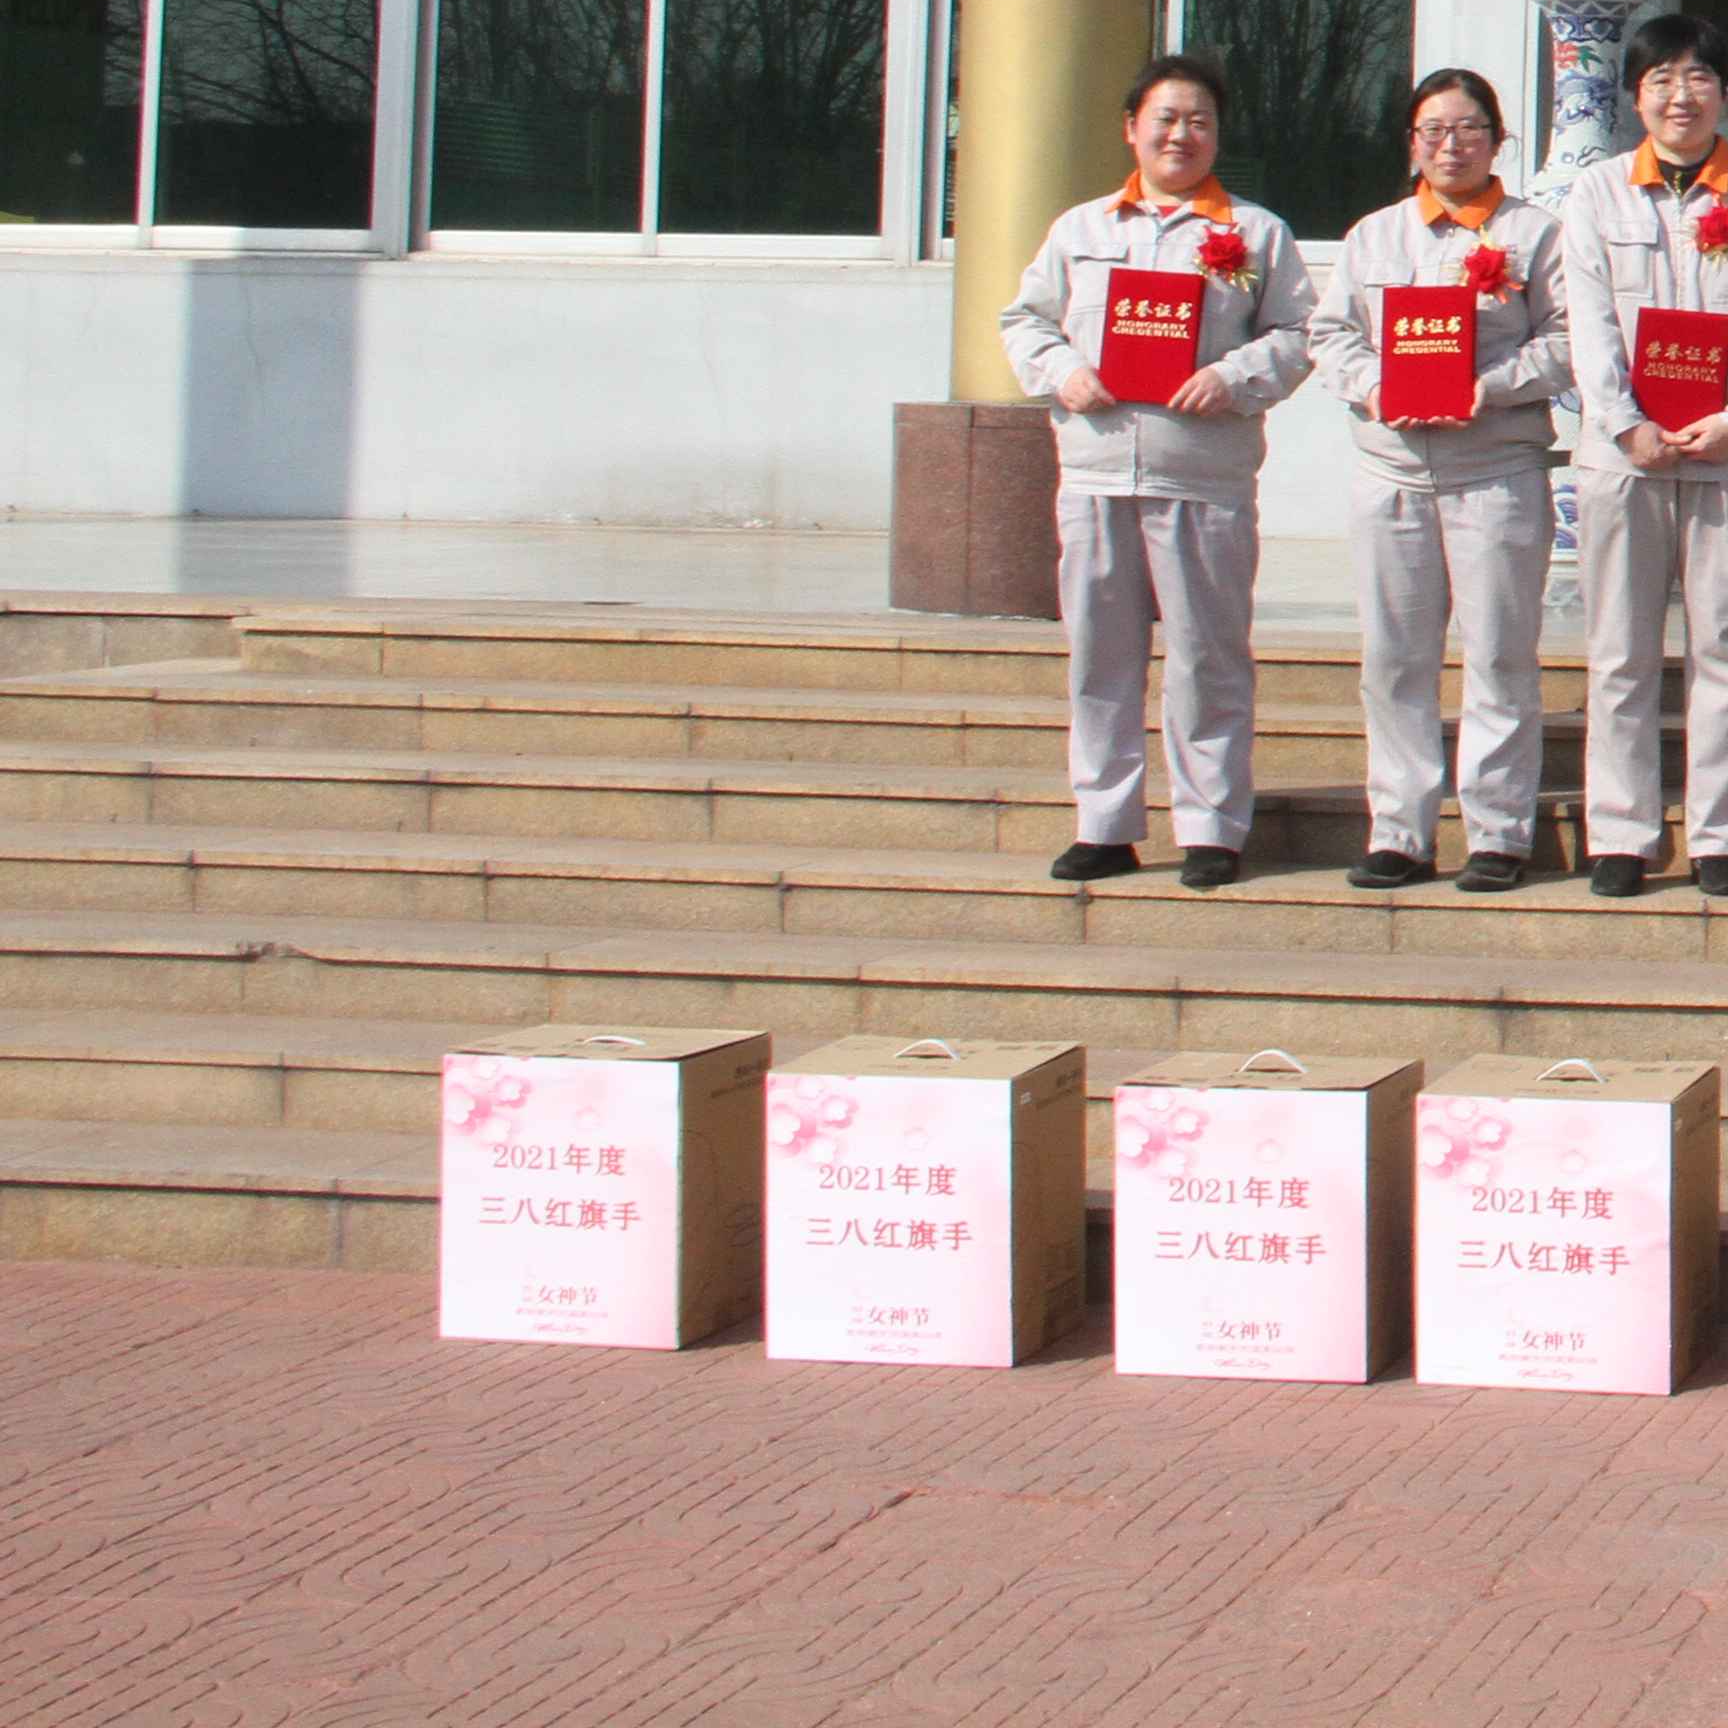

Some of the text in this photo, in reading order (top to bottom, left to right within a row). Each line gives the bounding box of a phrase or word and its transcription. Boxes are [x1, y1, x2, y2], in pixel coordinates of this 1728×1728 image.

[1114, 298, 1192, 320] 荣誉证书
[1112, 326, 1189, 339] CREDENTIAL
[1117, 319, 1187, 331] HONORARY
[1393, 316, 1462, 336] 荣誉证书
[1393, 346, 1461, 354] CREDENTIAL
[1646, 340, 1723, 364] 荣誉证书
[1643, 368, 1720, 383] CREDENTIAL
[1647, 362, 1716, 374] HONORARY
[488, 1141, 626, 1177] 2021年度
[819, 1162, 957, 1196] 2021年度
[1168, 1174, 1310, 1209] 2021年度
[1471, 1183, 1614, 1221] 2021年度
[479, 1196, 641, 1232] 三八红旗手
[806, 1217, 973, 1252] 三八红旗手
[1156, 1231, 1327, 1265] 三八红旗手
[1458, 1240, 1631, 1276] 三八红旗手
[537, 1284, 599, 1306] 女神节
[867, 1306, 930, 1329] 女神节
[1218, 1320, 1281, 1341] 女神节
[1522, 1329, 1585, 1352] 女神节
